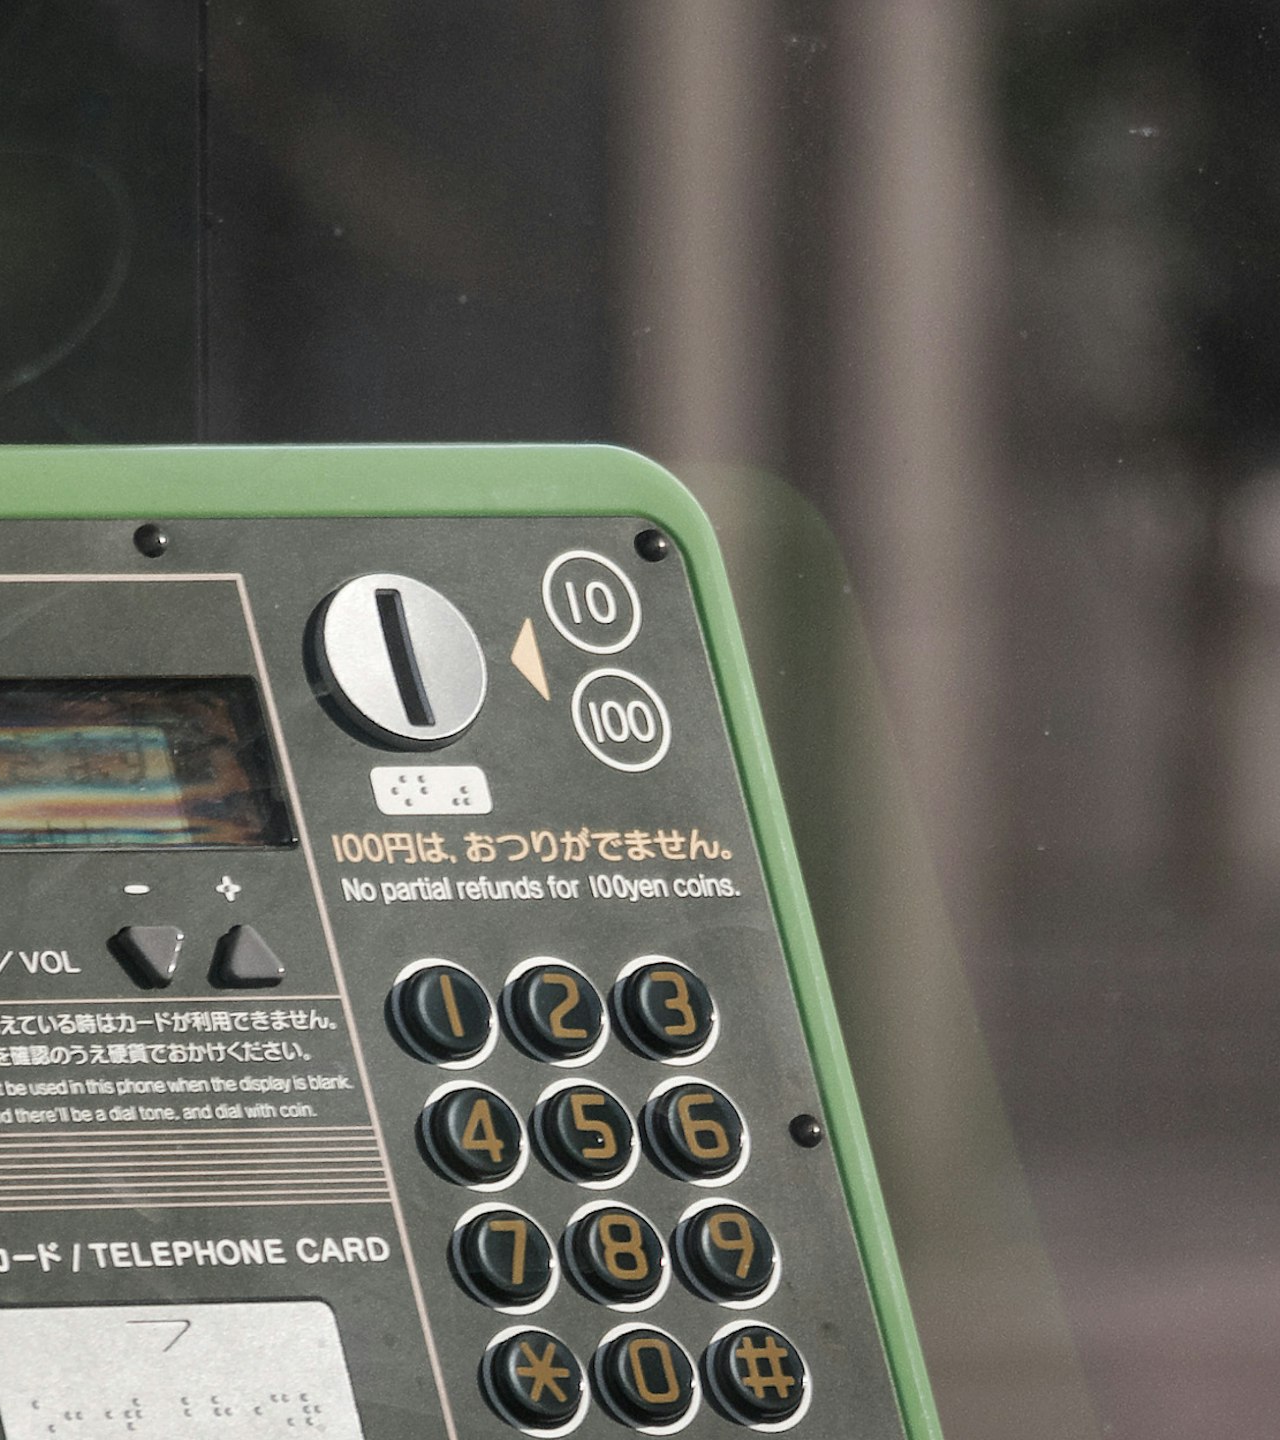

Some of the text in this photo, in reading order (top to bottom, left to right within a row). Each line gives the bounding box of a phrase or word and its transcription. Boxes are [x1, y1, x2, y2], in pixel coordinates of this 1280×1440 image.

[563, 580, 617, 626] 10
[588, 700, 657, 744] 100
[341, 872, 742, 906] No partial refunds for 100yen coins.
[439, 970, 697, 1039] 1 2 3
[5, 1080, 27, 1097] be
[28, 1079, 69, 1096] used
[70, 1079, 85, 1095] in
[85, 1078, 115, 1095] this
[116, 1076, 167, 1095] phone
[167, 1076, 211, 1093] when
[211, 1076, 239, 1092] the
[239, 1074, 292, 1094] display
[293, 1075, 308, 1091] is
[14, 1107, 70, 1124] there'll
[71, 1106, 94, 1123] be
[95, 1110, 108, 1123] a
[108, 1105, 139, 1121] dial
[182, 1103, 213, 1120] and
[214, 1103, 244, 1119] dial
[244, 1102, 278, 1118] with
[279, 1102, 319, 1118] coin.
[460, 1093, 730, 1164] 4 5 6
[89, 1237, 288, 1269] TELEPHONE
[295, 1235, 392, 1263] CARD
[488, 1211, 755, 1287] 7 8 9
[628, 1337, 681, 1405] 0
